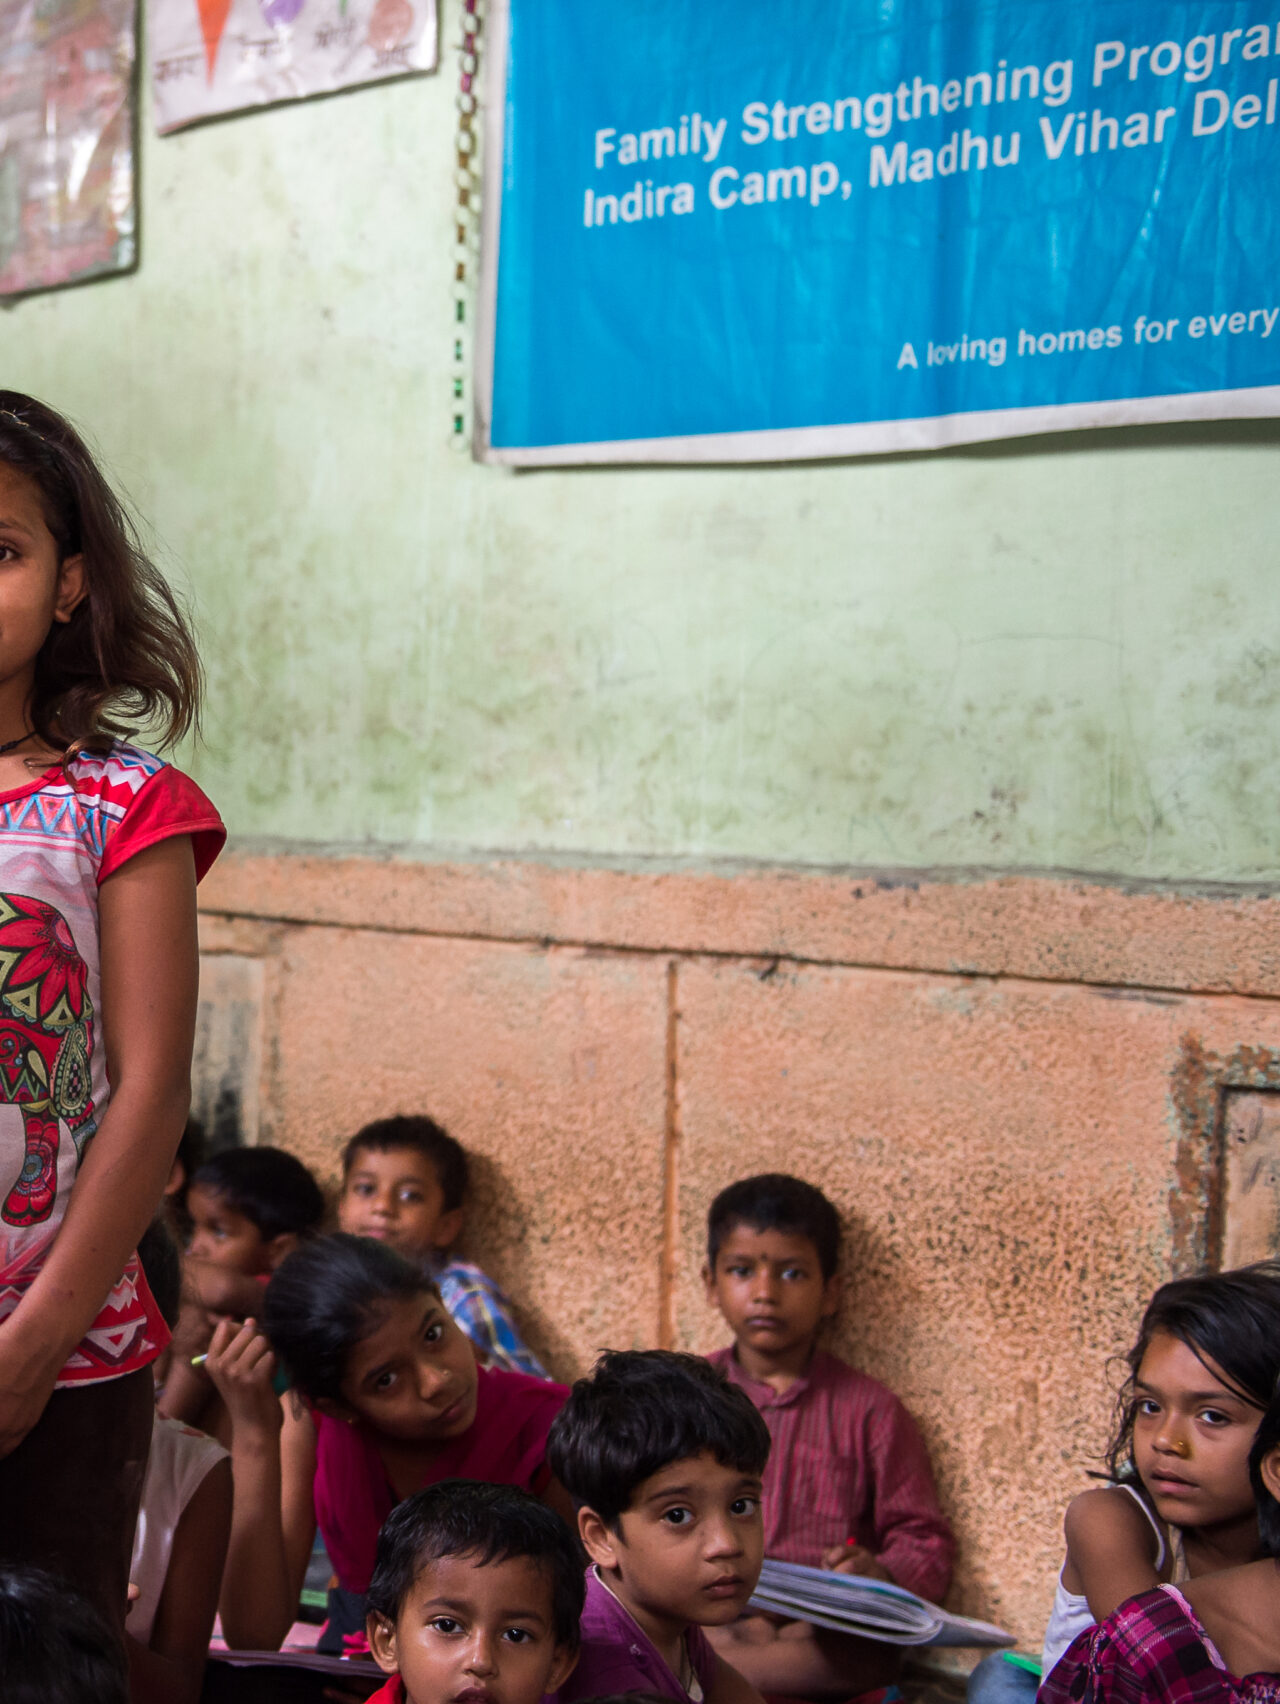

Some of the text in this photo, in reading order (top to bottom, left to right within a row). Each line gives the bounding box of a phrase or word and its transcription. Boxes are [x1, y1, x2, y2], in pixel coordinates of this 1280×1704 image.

[583, 79, 1279, 229] Indira Camp, Madhu Vihar Del
[595, 22, 1280, 169] Family Strengthening Progra
[897, 308, 1280, 370] A loving homes for every
